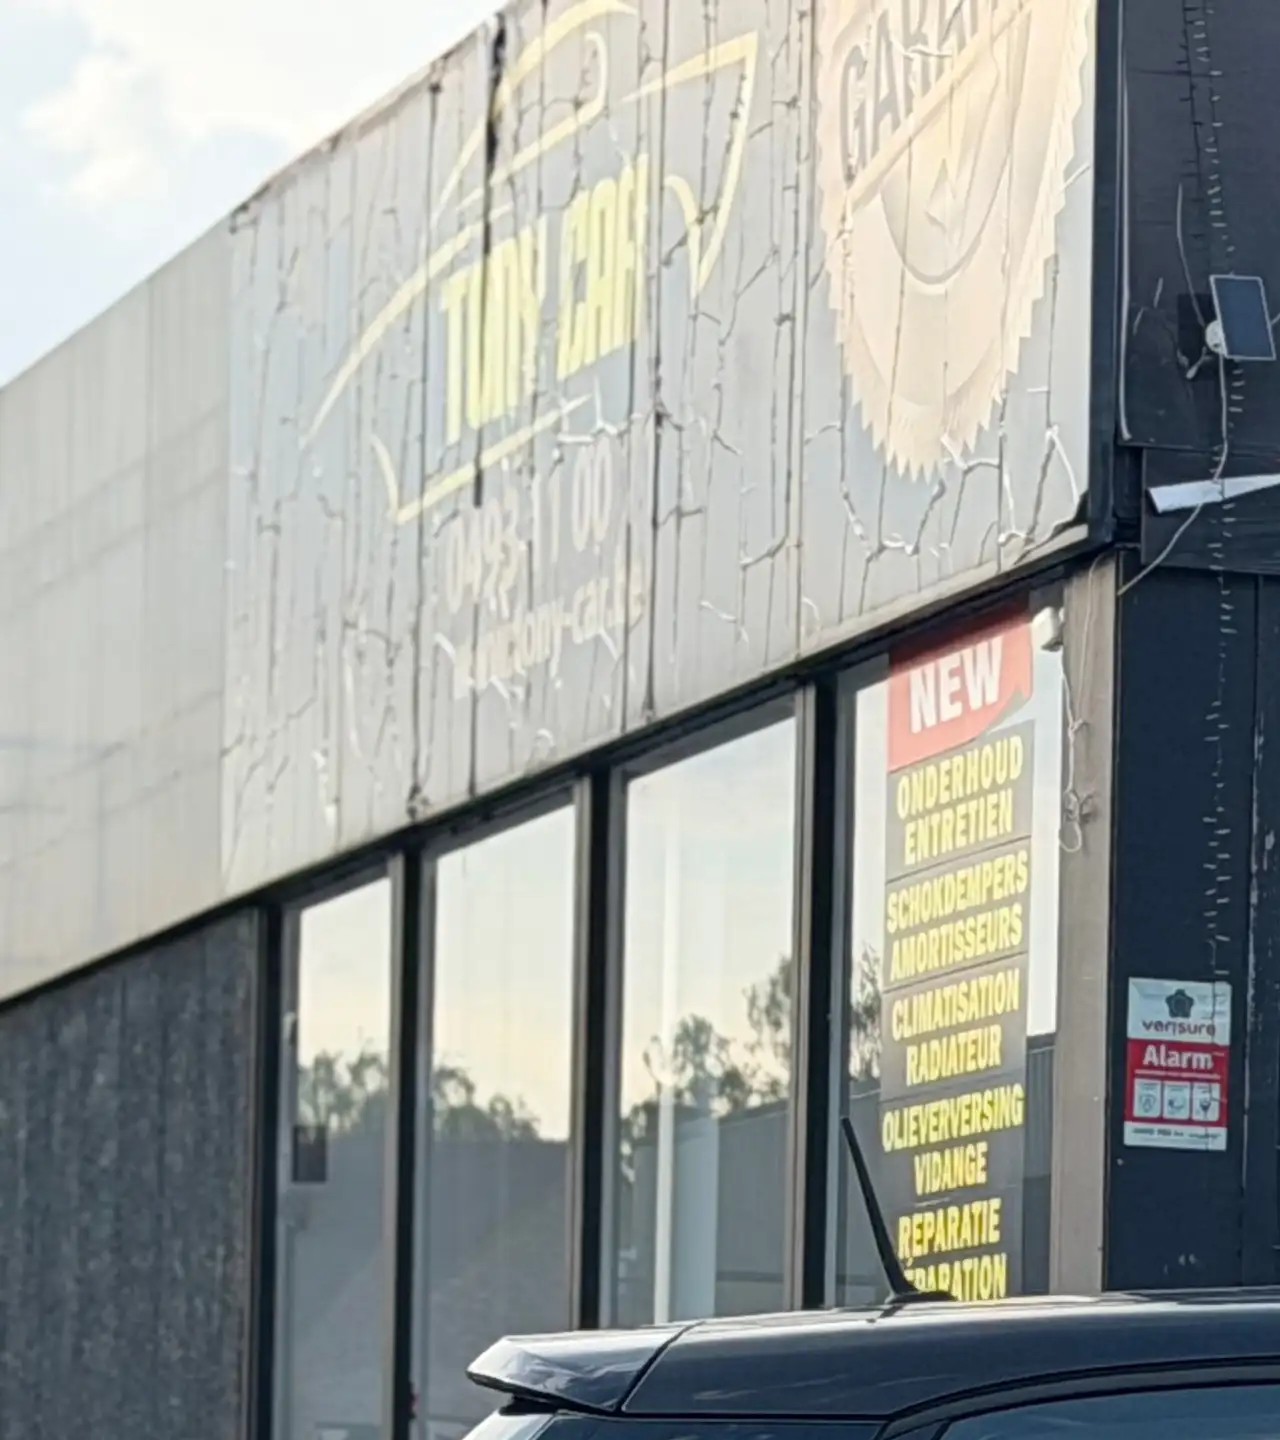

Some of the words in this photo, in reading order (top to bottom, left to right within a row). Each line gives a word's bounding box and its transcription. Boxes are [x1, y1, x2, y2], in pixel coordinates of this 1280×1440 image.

[556, 153, 648, 380] CAR
[910, 635, 1004, 733] NEW
[898, 735, 1023, 819] ONDERHOUD
[905, 789, 1013, 865] ENTRETIEN
[887, 850, 1028, 934] SCHOKDEMPERS
[891, 905, 1022, 982] AMORTISSEURS
[892, 968, 1020, 1041] CLIMATISATION
[1142, 1019, 1217, 1037] verisure
[906, 1027, 1001, 1087] RADIATEUR
[1142, 1043, 1214, 1070] Alarm
[882, 1084, 1024, 1152] OLIEVERVERSING
[914, 1144, 988, 1195] VIDANGE
[898, 1198, 1002, 1259] REPARATIE
